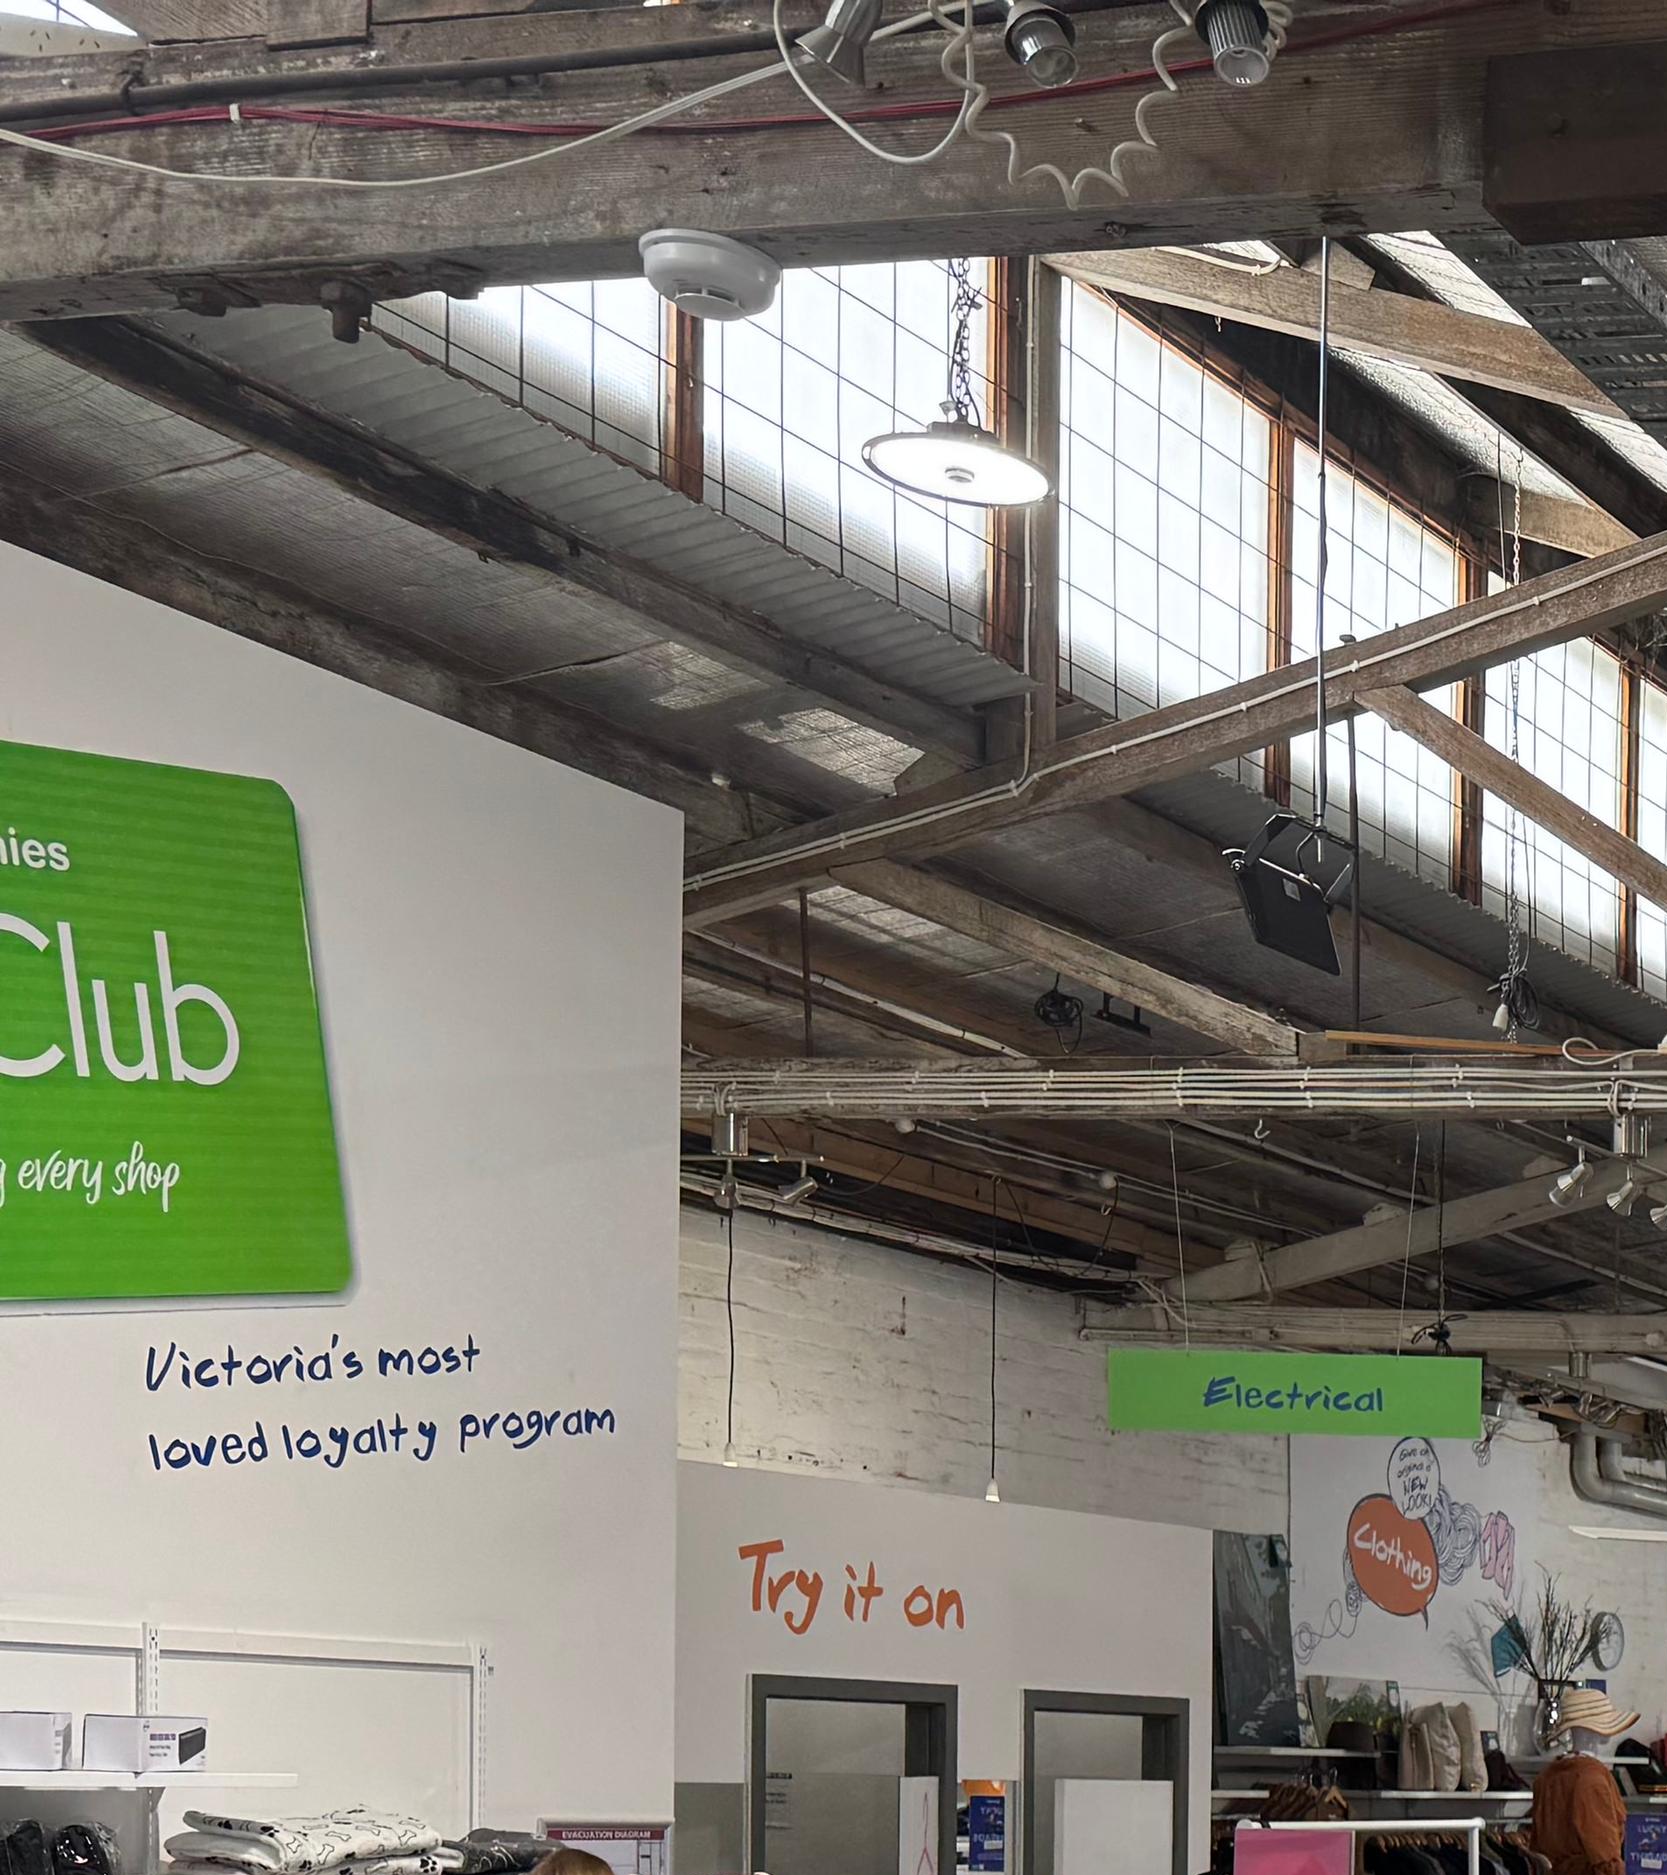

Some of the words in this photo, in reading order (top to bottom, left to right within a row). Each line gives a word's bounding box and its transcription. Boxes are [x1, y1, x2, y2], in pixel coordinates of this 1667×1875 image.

[18, 1151, 102, 1205] every
[112, 1140, 181, 1212] shop
[144, 1334, 364, 1392] Victoria's
[378, 1334, 481, 1378] most
[1203, 1375, 1384, 1414] Electrical
[149, 1421, 269, 1471] loved
[282, 1419, 438, 1468] loyalty
[459, 1406, 616, 1452] program
[1404, 1478, 1428, 1495] NEW
[738, 1539, 824, 1635] Try
[844, 1561, 883, 1621] it
[904, 1586, 966, 1631] on
[1354, 1524, 1432, 1590] Clothing
[562, 1831, 613, 1839] EVACUATION
[615, 1831, 651, 1839] DIAGRAM
